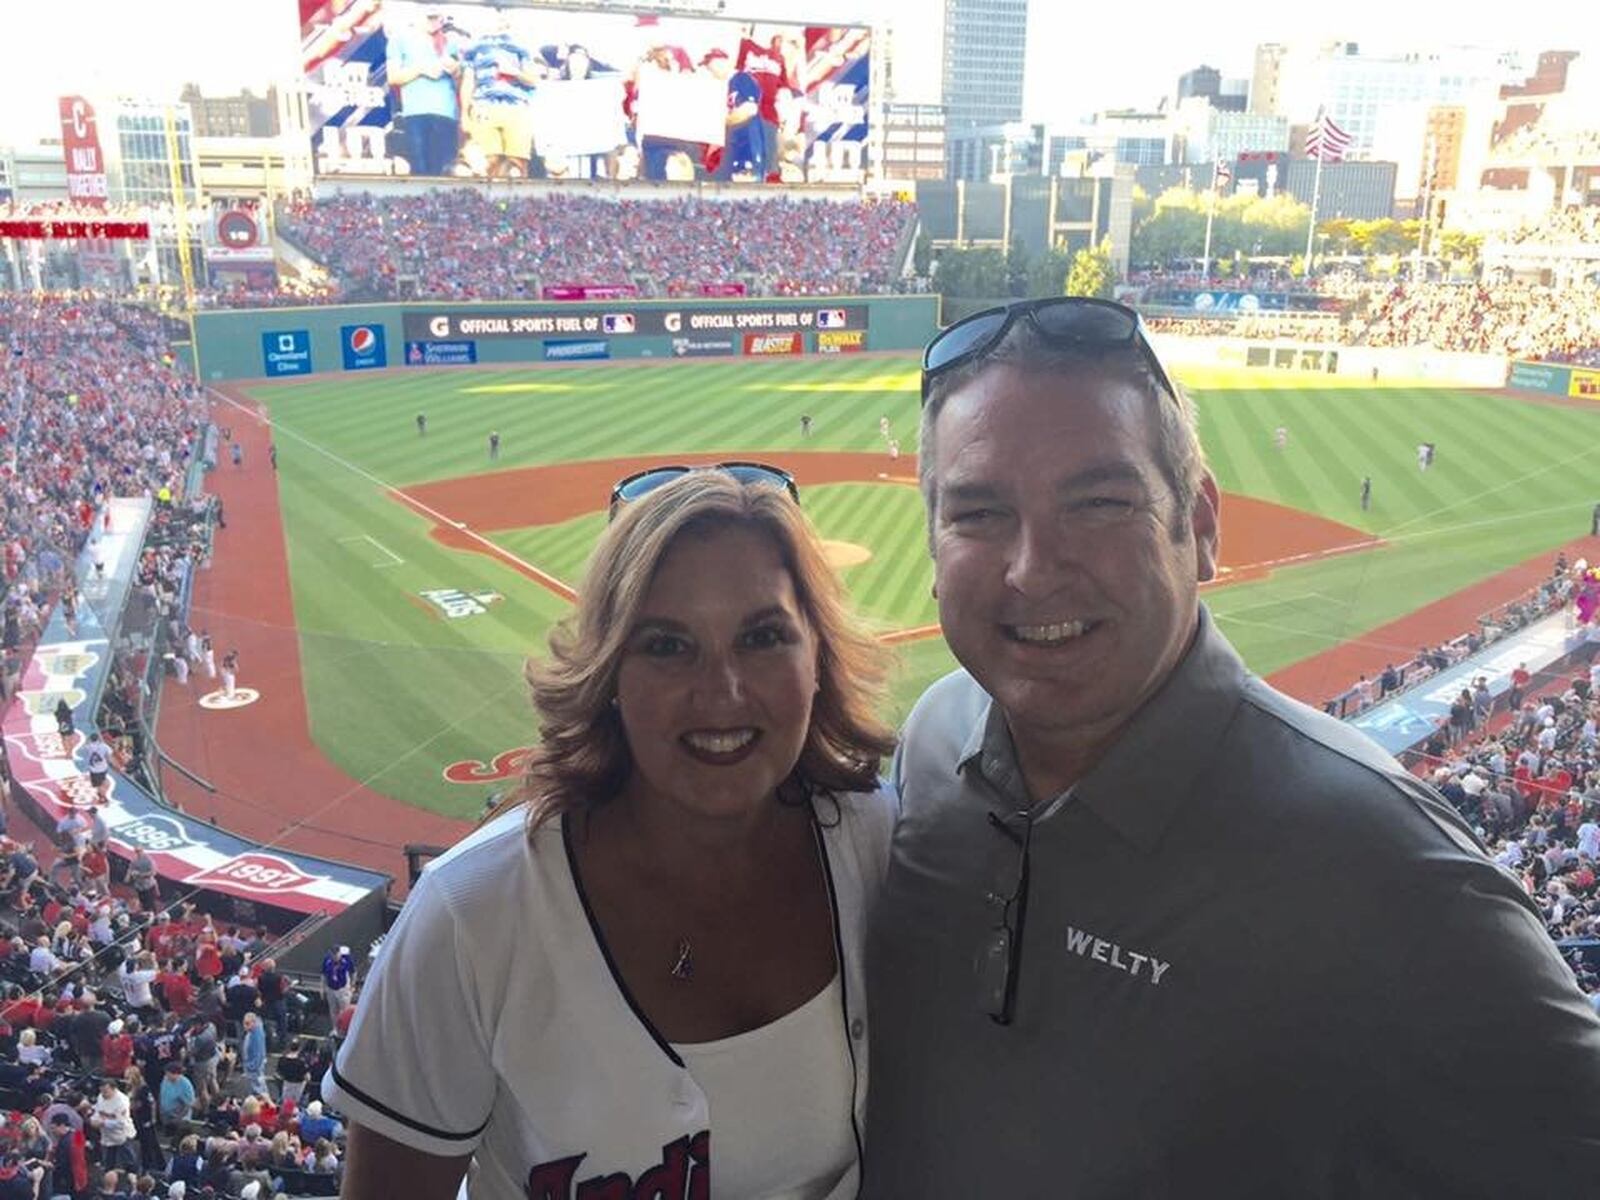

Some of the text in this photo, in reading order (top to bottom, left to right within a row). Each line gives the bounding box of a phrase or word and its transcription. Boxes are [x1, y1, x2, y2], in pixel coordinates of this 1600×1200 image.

[430, 316, 599, 337] G OFFICIAL SPORTS FUEL OF
[664, 313, 813, 332] G OFFICIAL SPORTS FUEL OF
[268, 350, 308, 362] Cleveland
[115, 821, 183, 850] 1996
[218, 861, 302, 888] 1997
[1066, 926, 1171, 985] WELTY
